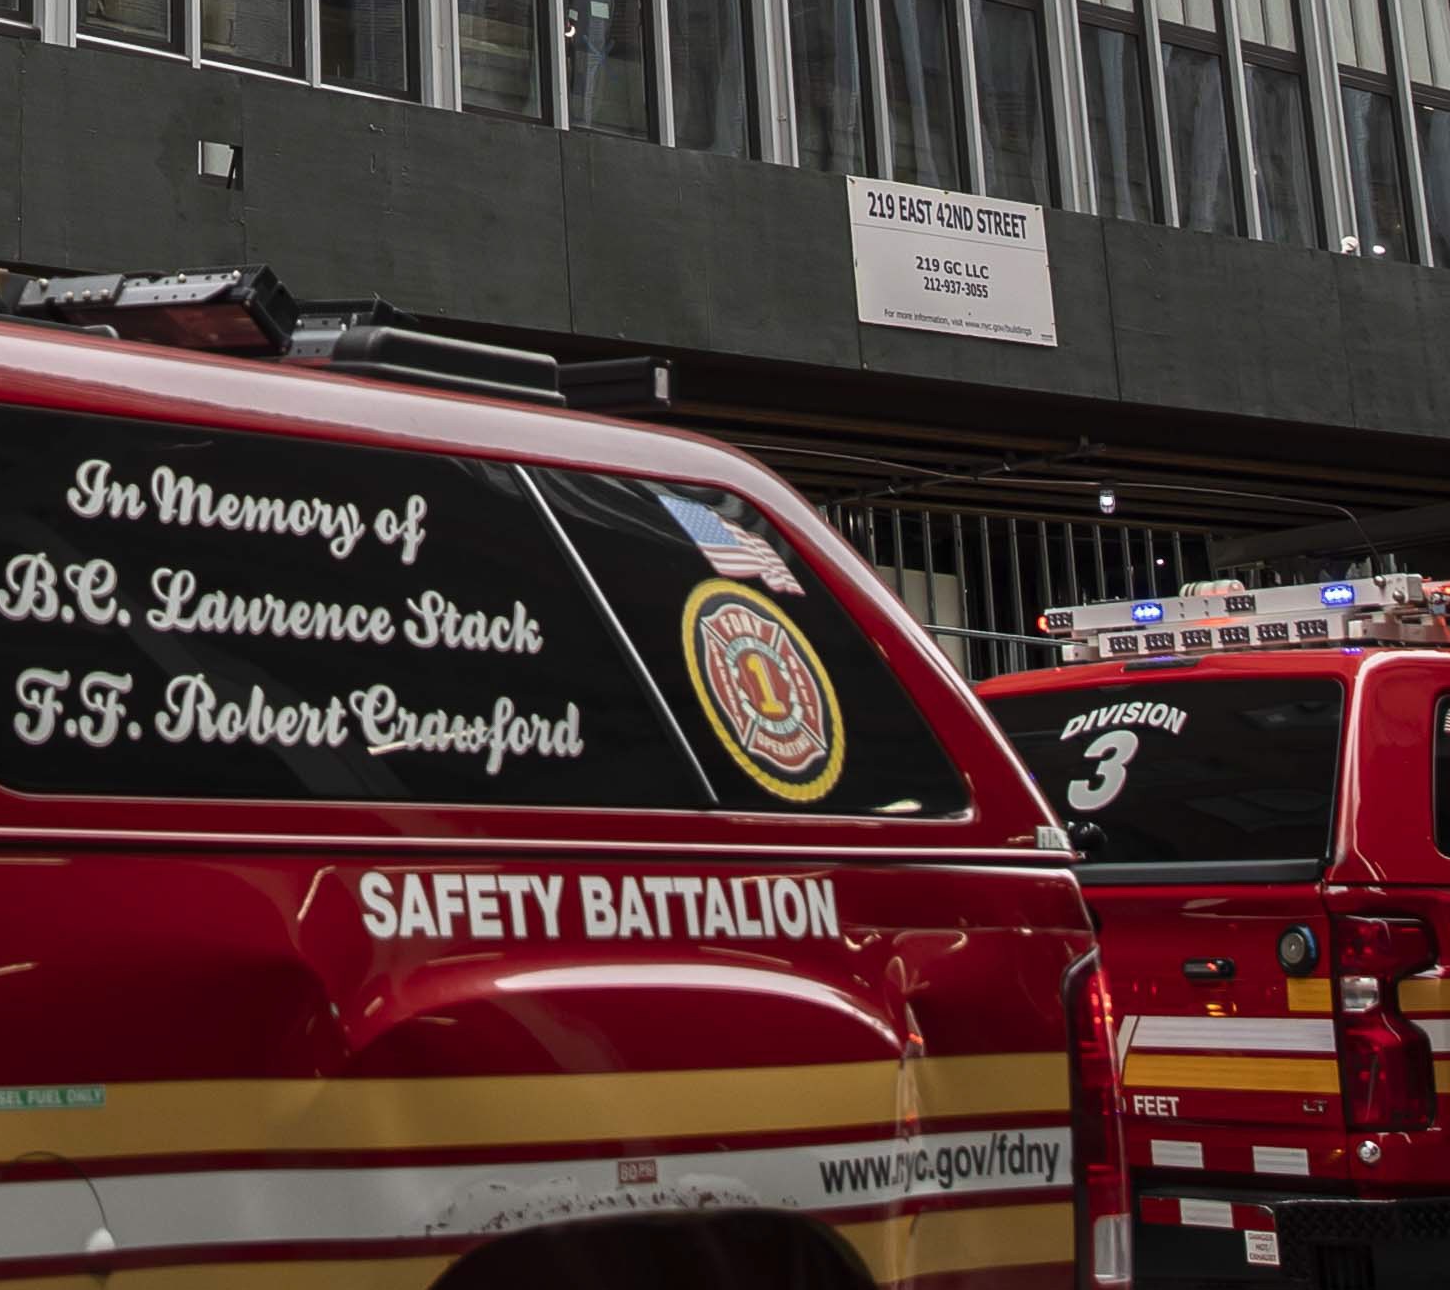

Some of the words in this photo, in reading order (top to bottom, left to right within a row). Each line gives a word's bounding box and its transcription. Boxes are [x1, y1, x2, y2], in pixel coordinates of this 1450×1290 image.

[867, 191, 895, 219] 219
[898, 195, 932, 225] EAST
[937, 203, 973, 231] 42ND
[977, 209, 1027, 239] STREET
[915, 255, 940, 272] 219
[943, 260, 962, 276] GC
[965, 264, 990, 279] LLC
[923, 276, 989, 298] 212-937-3055
[66, 459, 146, 519] In
[151, 465, 365, 560] Memory
[374, 495, 427, 565] of
[404, 590, 543, 653] Stack
[719, 612, 762, 636] FDNY
[747, 652, 787, 714] 1
[14, 668, 143, 748] F.F.
[155, 673, 348, 747] Robert
[350, 684, 584, 774] Crawford
[1060, 701, 1188, 741] DIVISION
[1067, 729, 1139, 811] 3
[359, 871, 564, 938] SAFETY
[579, 875, 839, 940] BATTALION
[26, 1088, 60, 1107] FUEL
[66, 1087, 103, 1106] ONLY
[1133, 1095, 1179, 1116] FEET
[819, 1133, 1061, 1194] www.nyc.gov/fdny
